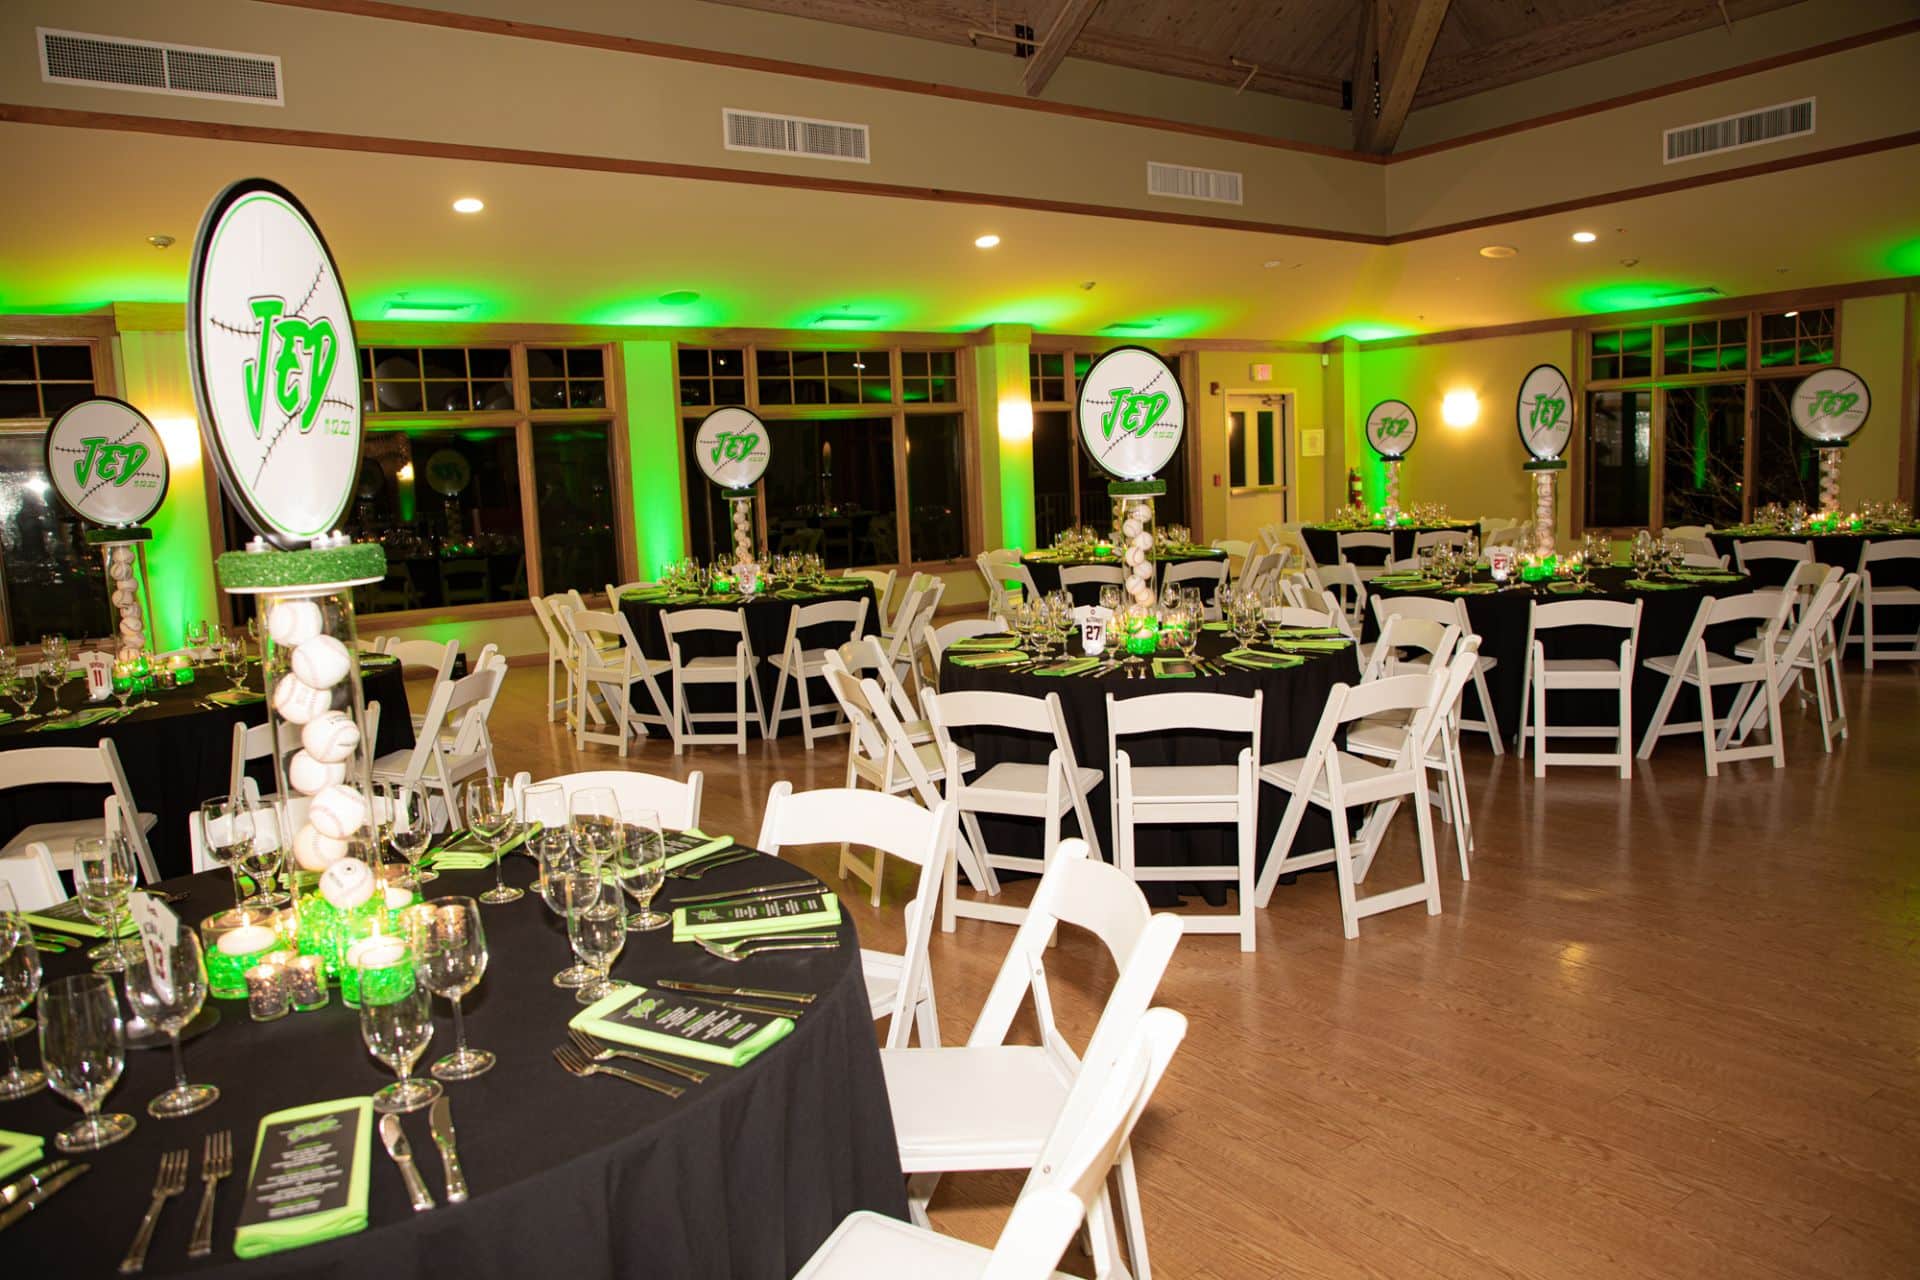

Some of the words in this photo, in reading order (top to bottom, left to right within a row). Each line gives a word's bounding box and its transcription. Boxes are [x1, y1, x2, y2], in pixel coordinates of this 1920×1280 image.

[243, 297, 339, 439] JED
[1101, 387, 1170, 441] JED
[74, 437, 150, 488] JED
[711, 431, 760, 465] JED
[1086, 625, 1102, 641] 27
[92, 669, 103, 687] 11
